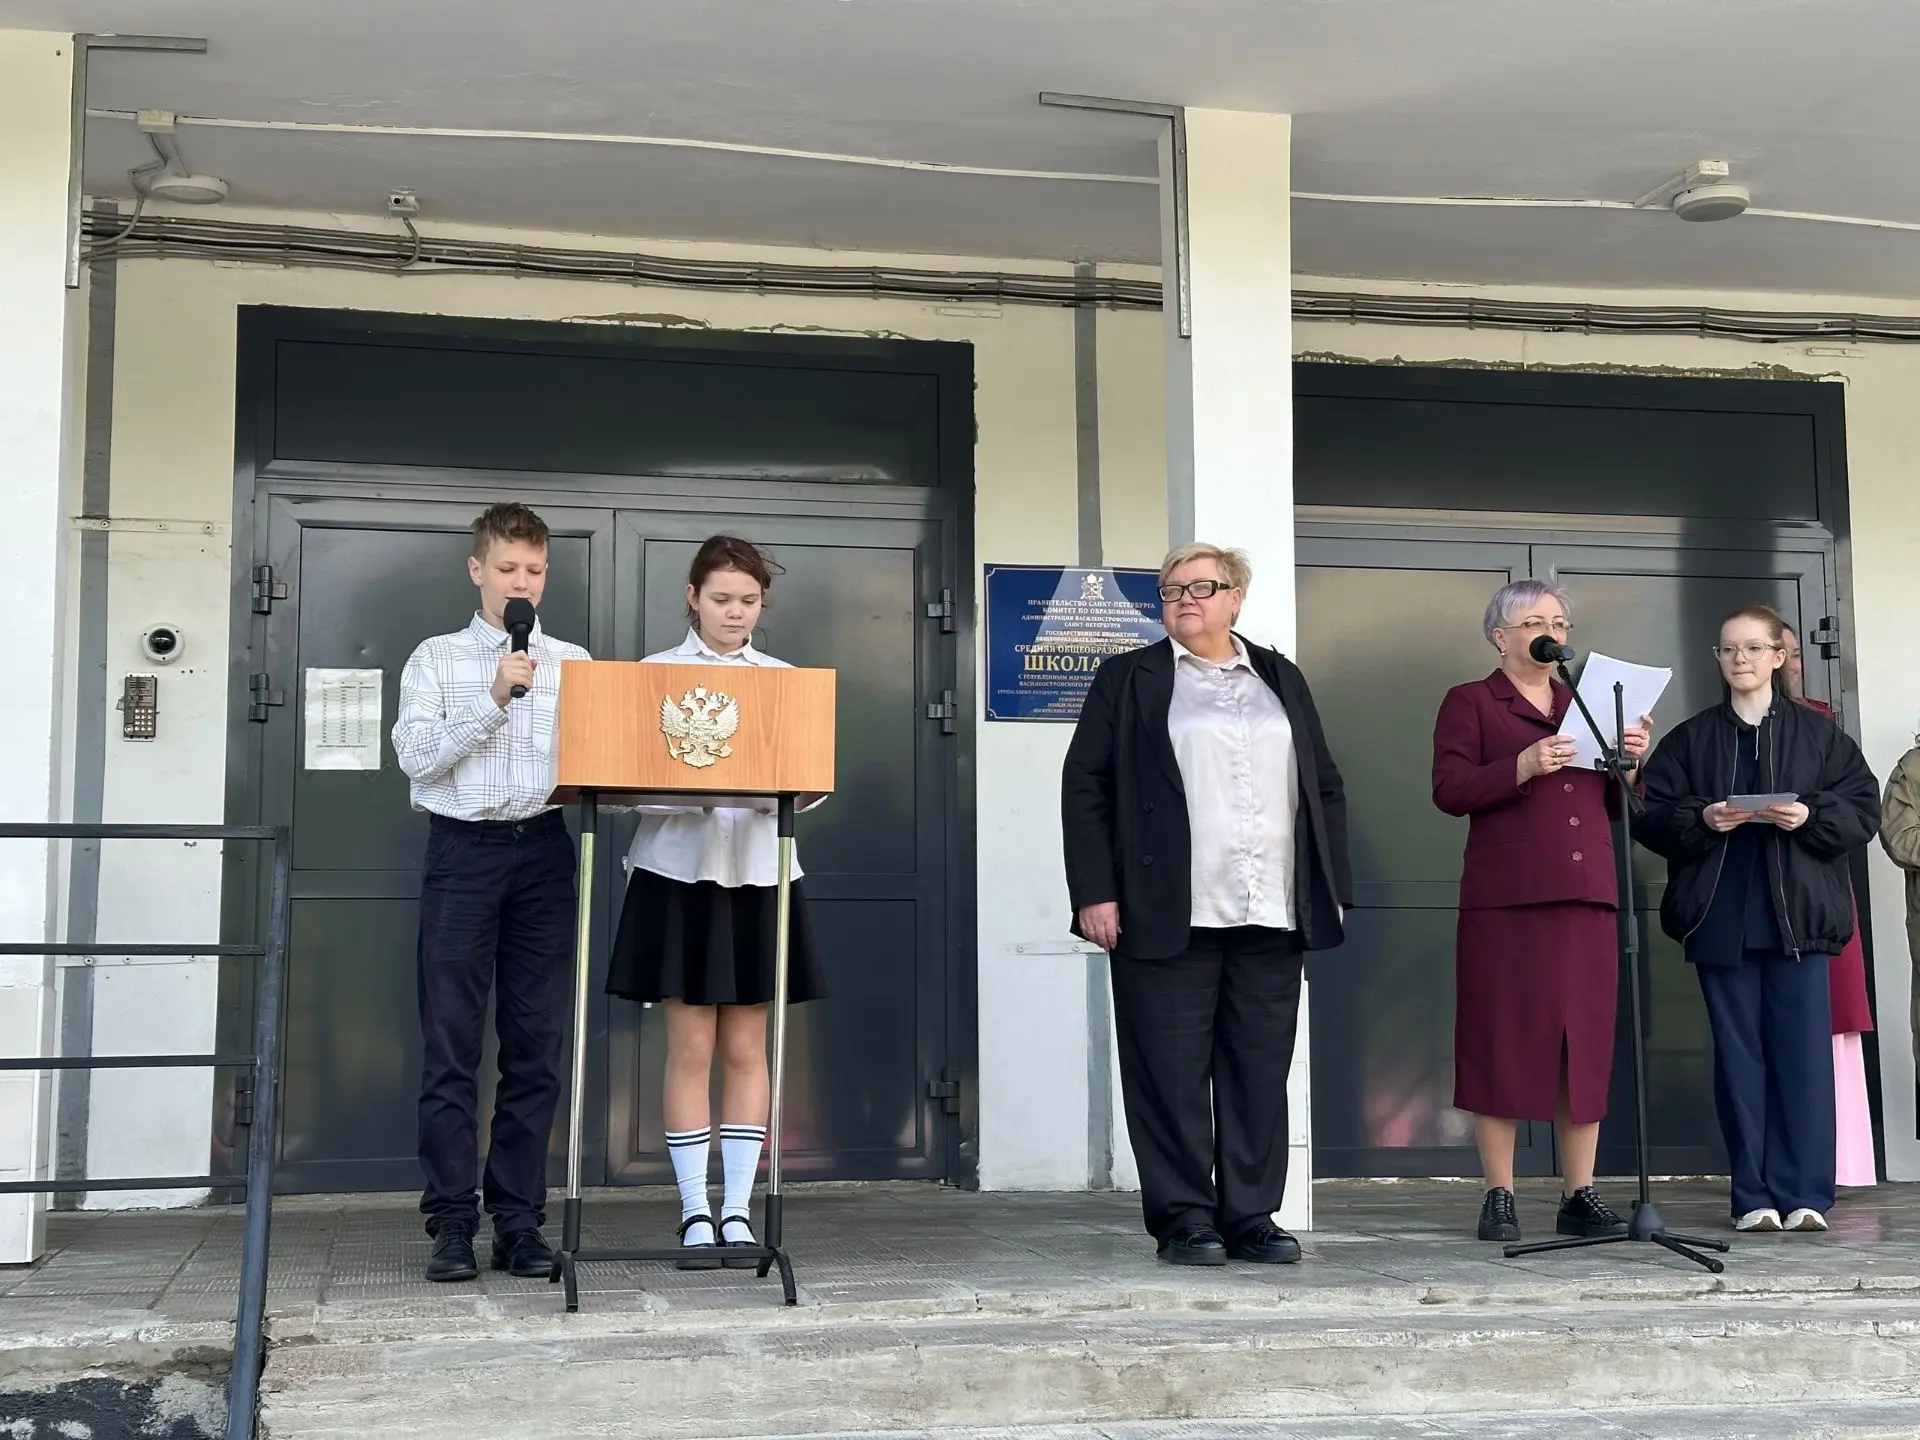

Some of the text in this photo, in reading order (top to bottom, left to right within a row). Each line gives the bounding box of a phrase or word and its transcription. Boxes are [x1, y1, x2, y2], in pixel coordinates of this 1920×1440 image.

[1088, 600, 1156, 609] САНКТ-ПЕТЕРБУРГА
[1014, 644, 1055, 653] СРЕДНЯЯ
[1024, 655, 1100, 672] ШКОЛА
